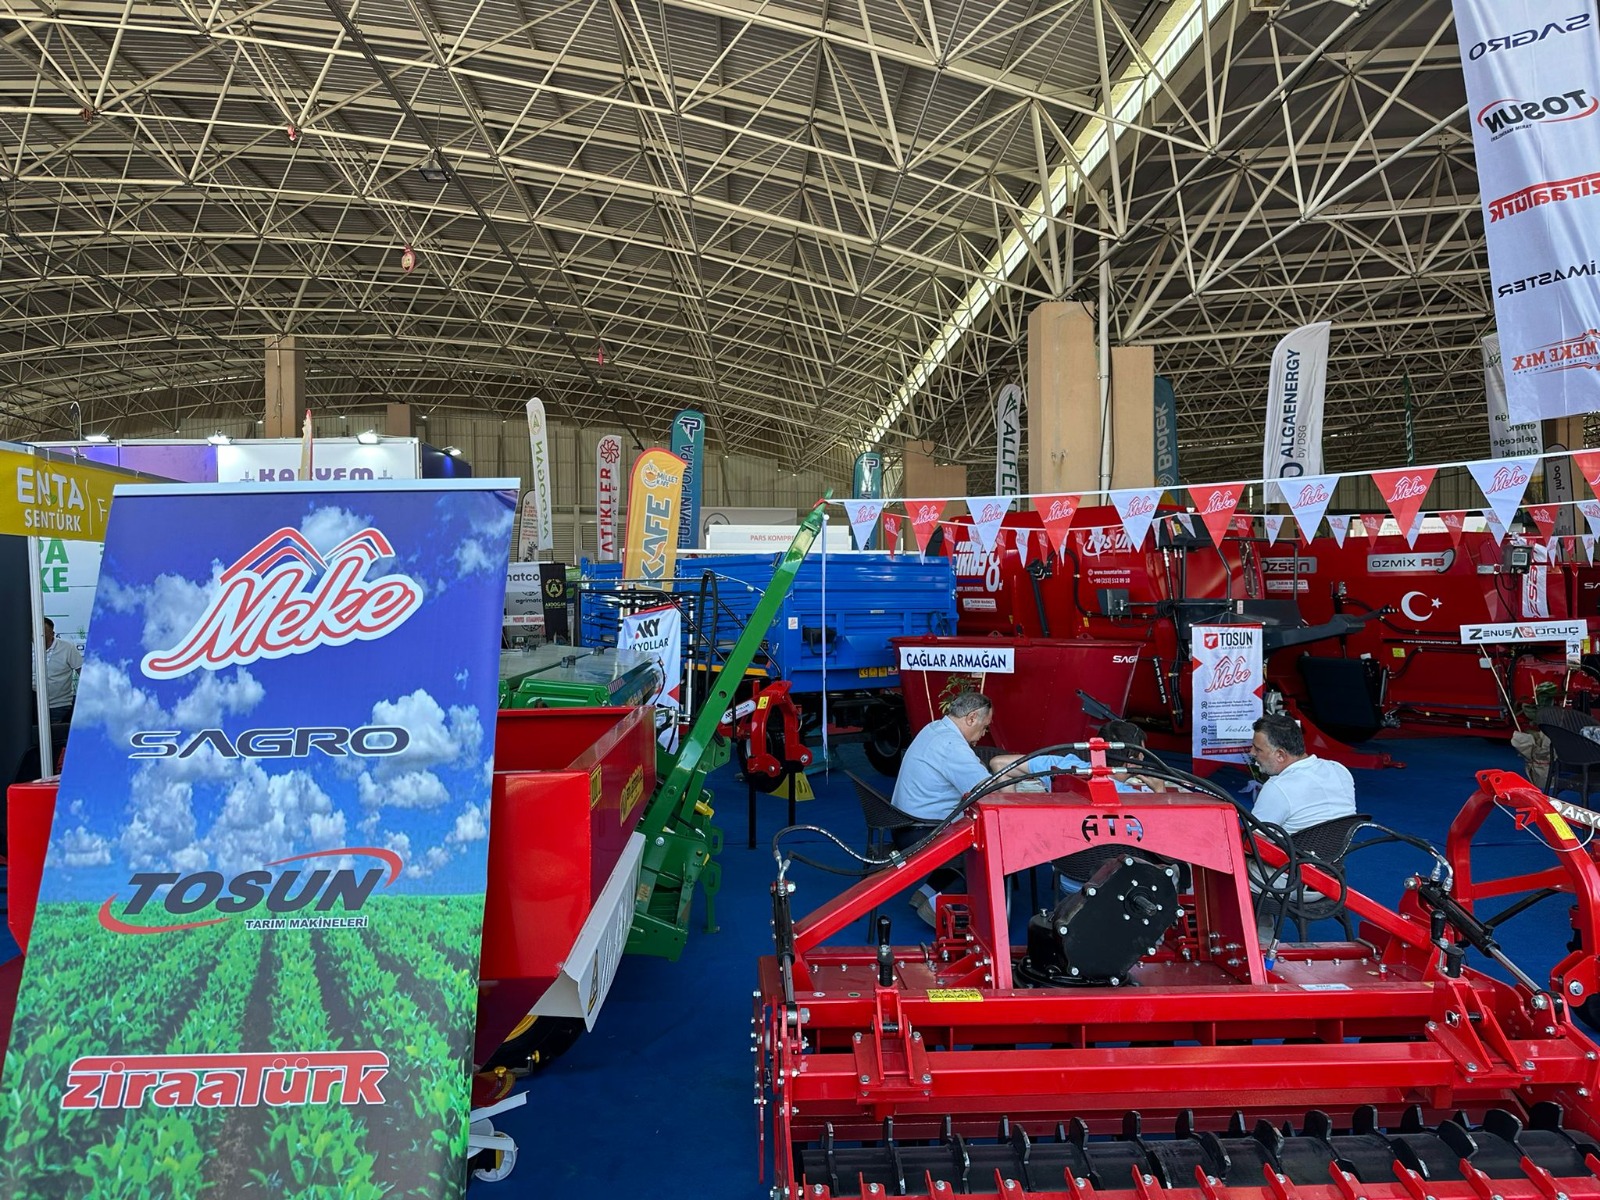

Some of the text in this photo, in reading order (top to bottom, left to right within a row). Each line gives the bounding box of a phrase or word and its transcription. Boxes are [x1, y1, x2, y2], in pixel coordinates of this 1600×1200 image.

[1280, 349, 1301, 458] ALGAENERGY
[1298, 425, 1307, 445] DSG
[17, 466, 85, 511] ENTA
[1387, 479, 1427, 502] Meke
[1485, 469, 1528, 494] Meke
[1122, 498, 1155, 520] Meke
[1202, 493, 1236, 515] Meke
[1292, 487, 1329, 509] Meke
[25, 509, 82, 532] ŞENTÜRK
[640, 494, 672, 591] KAFE
[141, 553, 424, 680] Meke
[1219, 631, 1253, 647] TOSUN
[906, 650, 1006, 670] ÇAĞLAR ARMAĞAN
[1205, 660, 1251, 693] Meke
[128, 725, 411, 760] SAGRO
[1081, 814, 1144, 842] ATA
[121, 867, 386, 915] TOSUN
[245, 915, 369, 930] TARIM MAKİNELERİ
